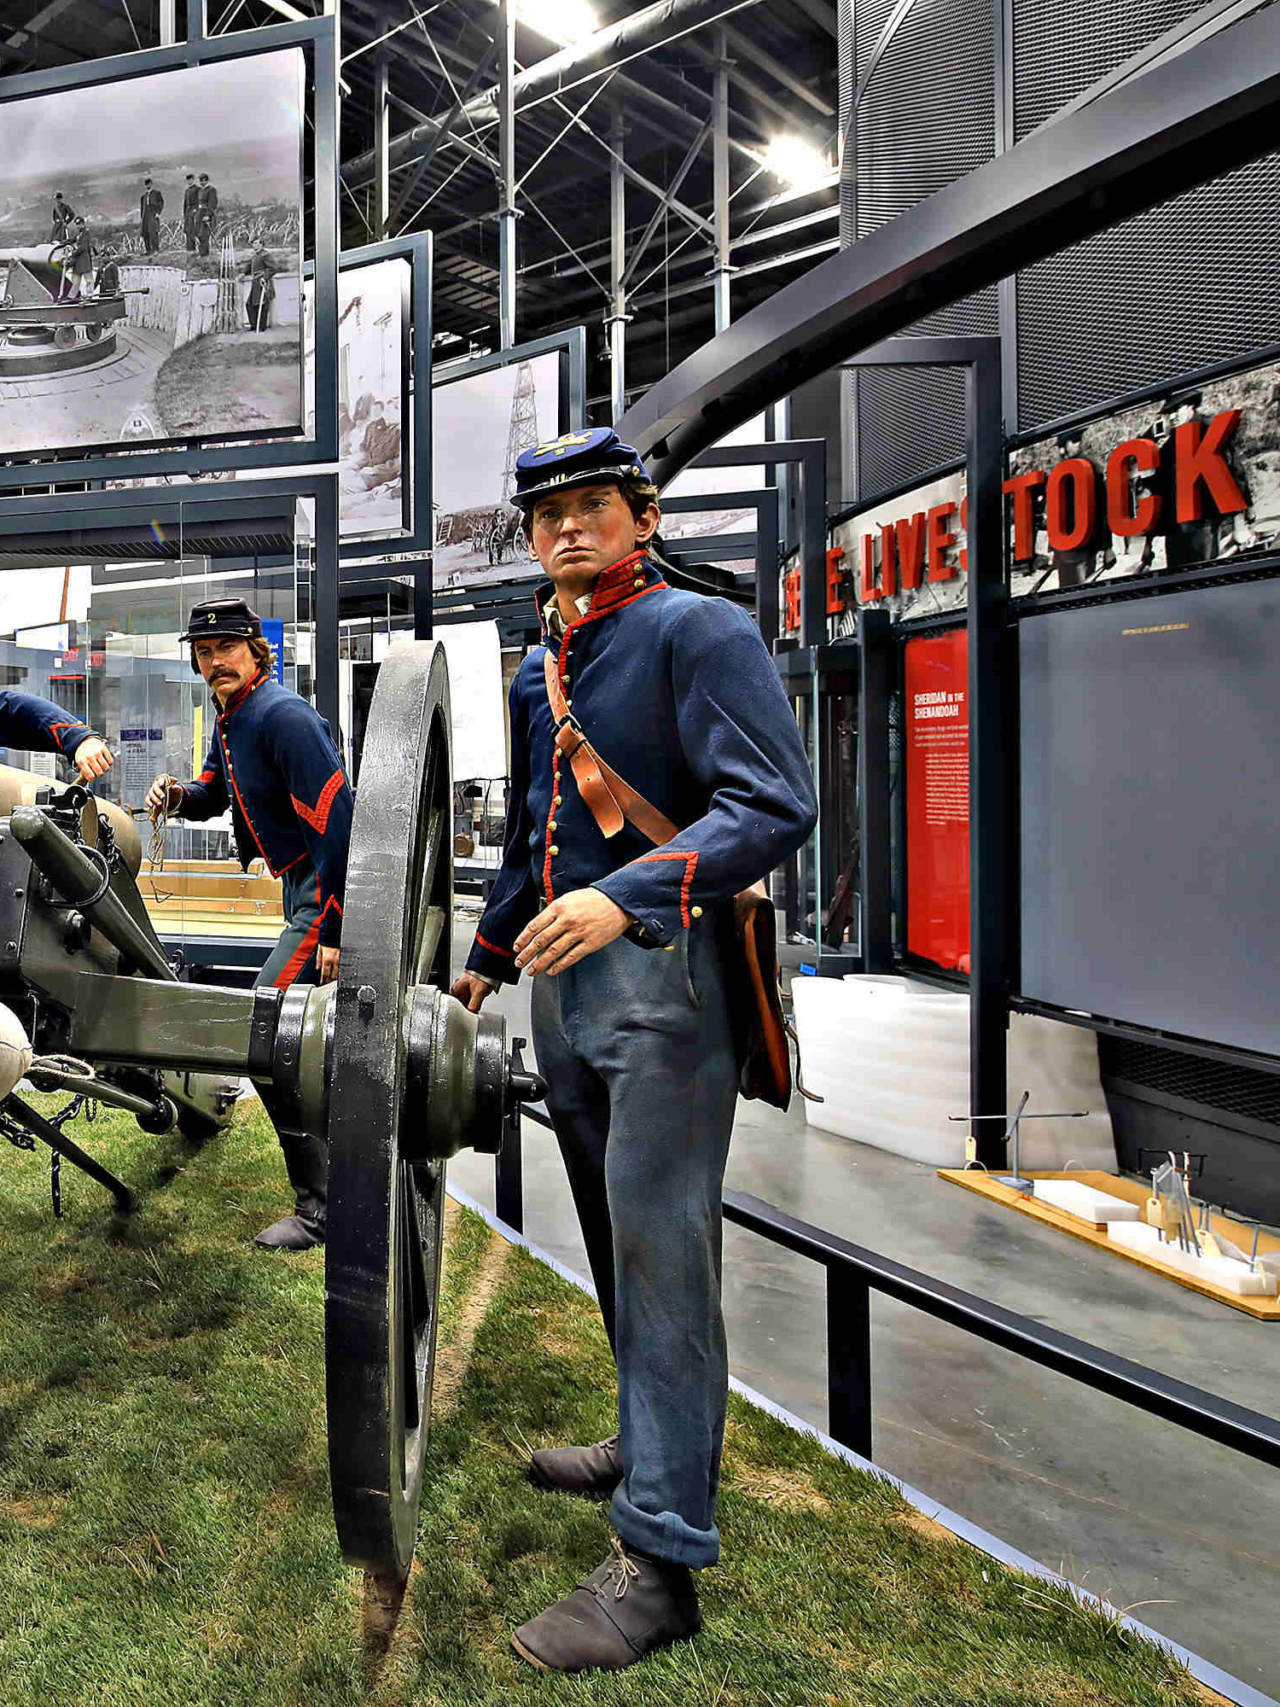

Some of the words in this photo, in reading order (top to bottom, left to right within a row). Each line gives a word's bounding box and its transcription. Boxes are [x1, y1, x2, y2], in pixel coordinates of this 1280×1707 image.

[208, 613, 217, 624] 2
[914, 691, 947, 706] SHERIDAN
[914, 704, 959, 719] SHENANDOAH
